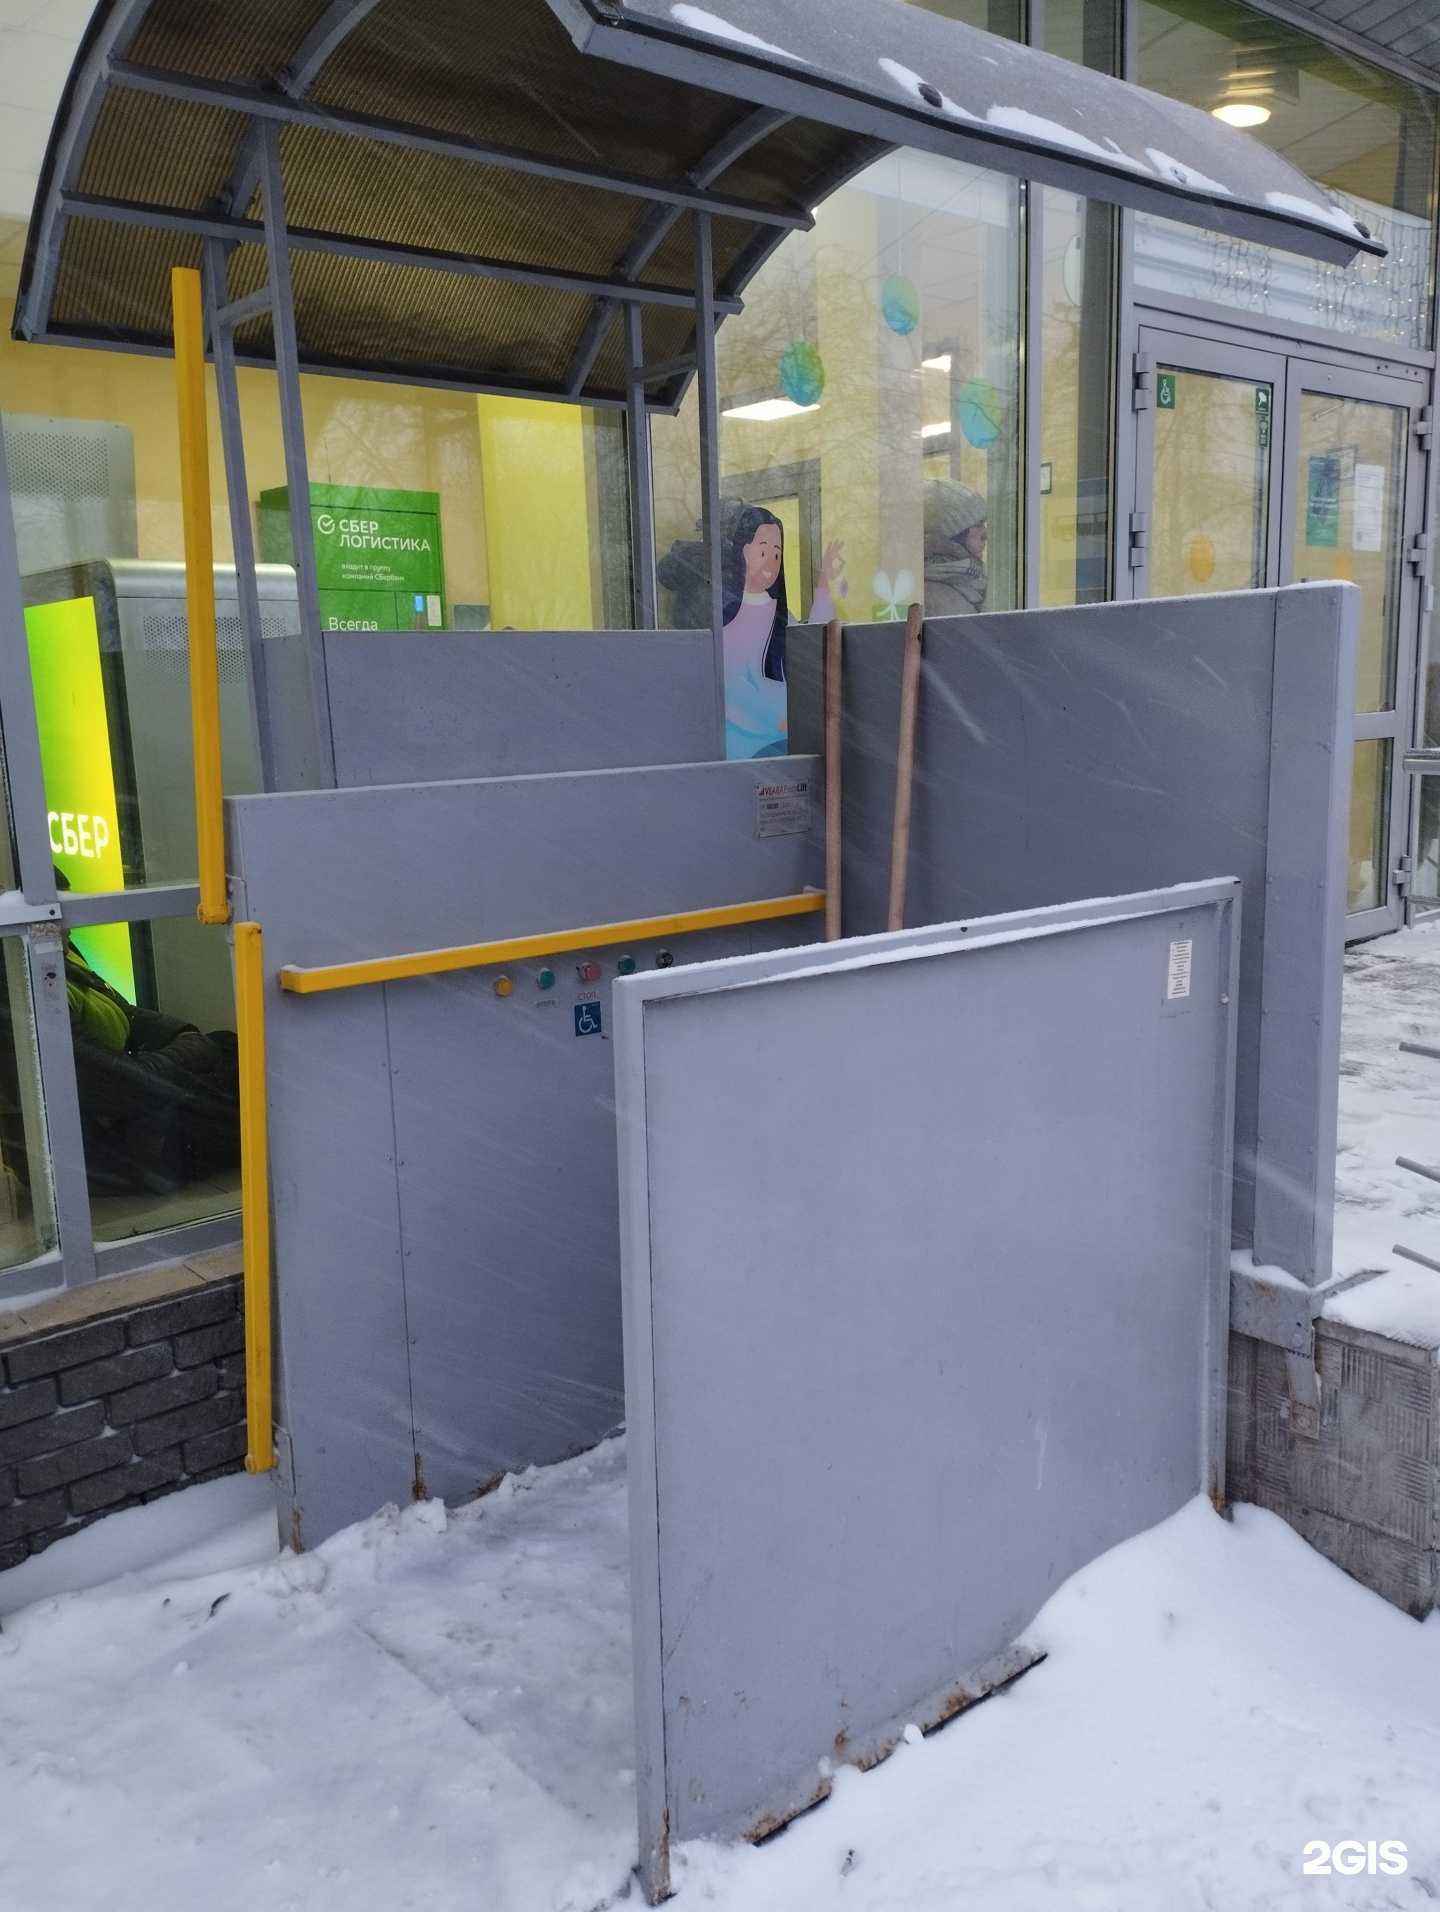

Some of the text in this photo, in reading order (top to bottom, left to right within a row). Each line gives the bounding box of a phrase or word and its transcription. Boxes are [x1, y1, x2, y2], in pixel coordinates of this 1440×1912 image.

[339, 519, 378, 534] СБЕР
[340, 535, 431, 551] ЛОГИСТИКА
[328, 617, 379, 631] Всегда
[47, 811, 109, 859] СБЕР
